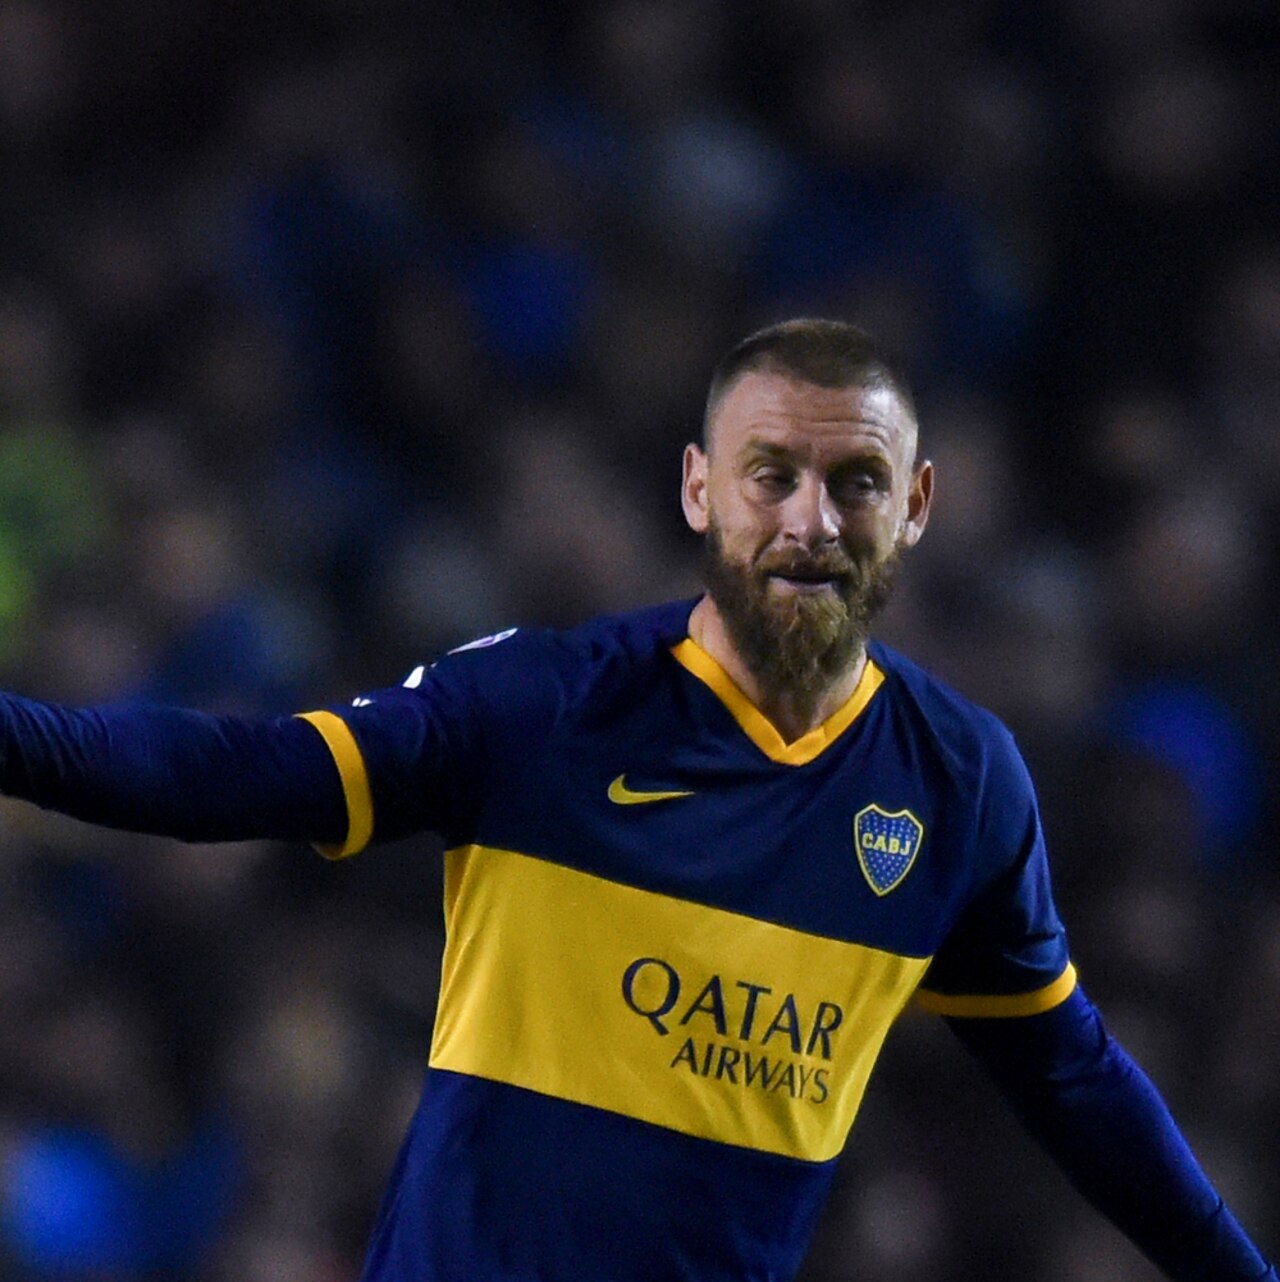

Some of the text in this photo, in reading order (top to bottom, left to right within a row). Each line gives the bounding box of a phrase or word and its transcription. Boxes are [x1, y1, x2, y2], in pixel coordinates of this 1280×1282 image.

[862, 832, 911, 856] CABJ
[621, 957, 843, 1061] QATAR
[670, 1037, 830, 1104] AIRWAYS
